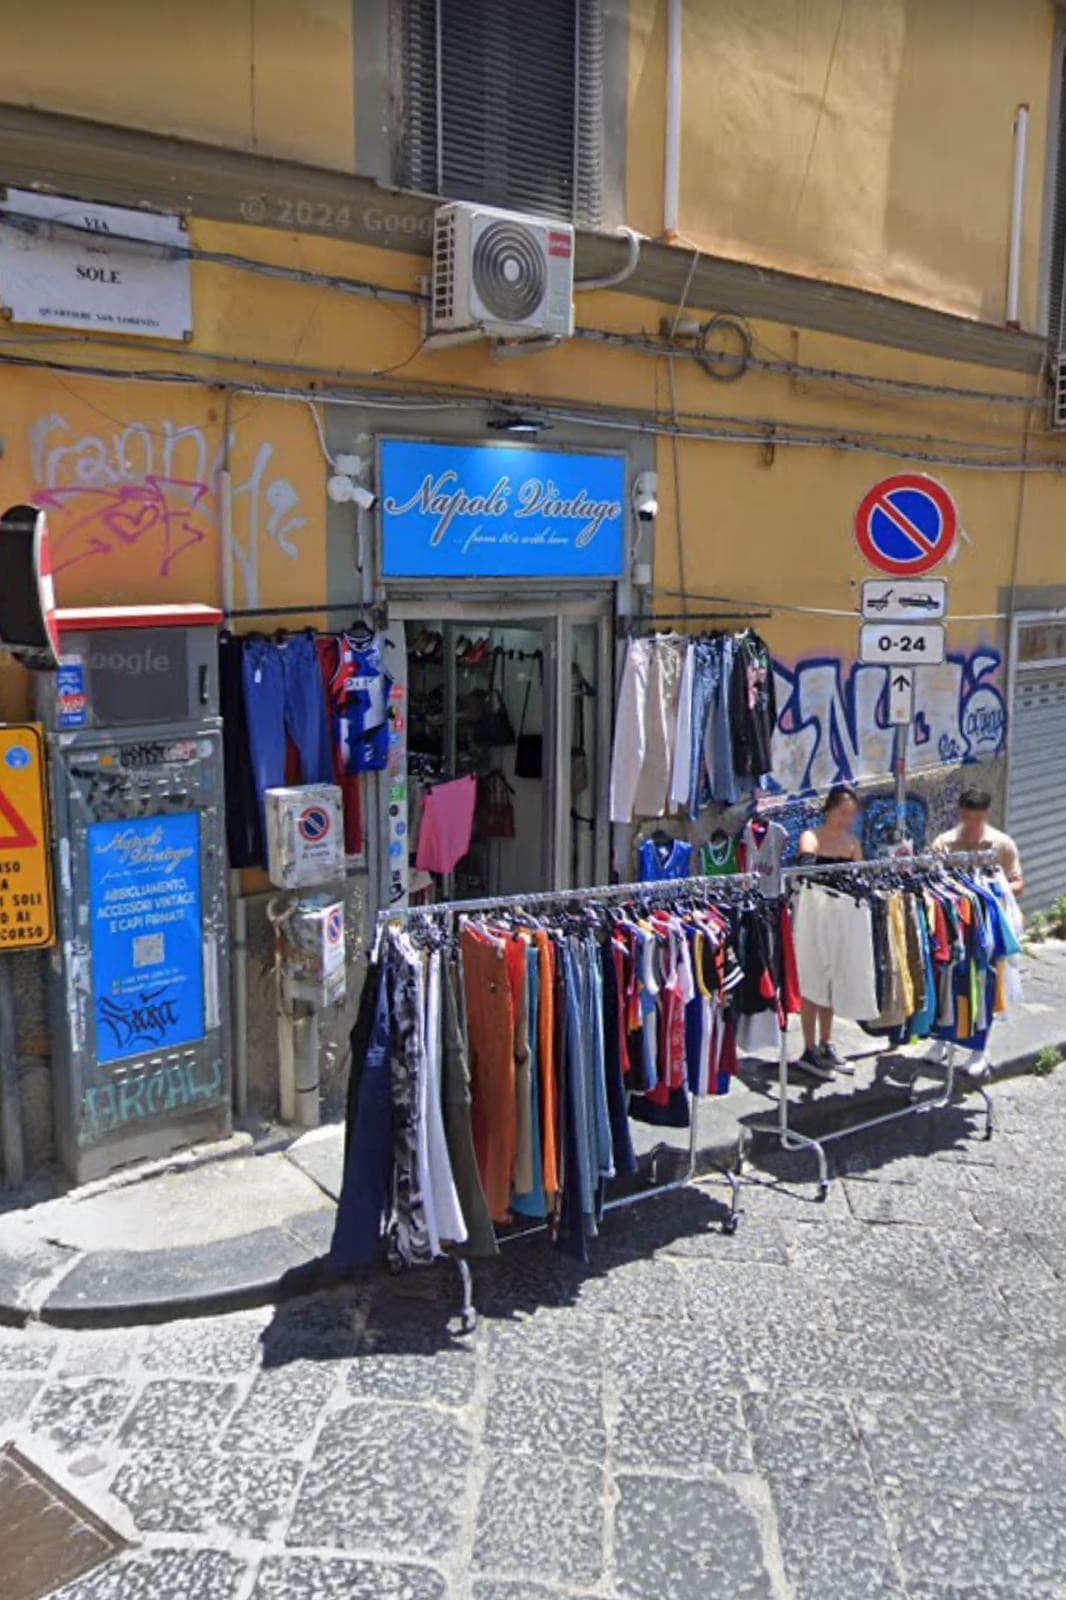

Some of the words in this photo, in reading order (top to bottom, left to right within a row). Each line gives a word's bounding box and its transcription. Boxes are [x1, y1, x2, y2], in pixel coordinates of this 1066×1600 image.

[83, 216, 110, 232] VIA
[75, 264, 122, 285] SOLE
[384, 470, 512, 547] Napoli
[513, 478, 622, 547] Vintage
[878, 636, 926, 651] 0-24
[12, 891, 42, 906] SOLI
[97, 899, 153, 919] ACCESSORI
[155, 891, 195, 909] VINTAGE
[110, 920, 118, 933] E
[119, 914, 144, 931] CAPI
